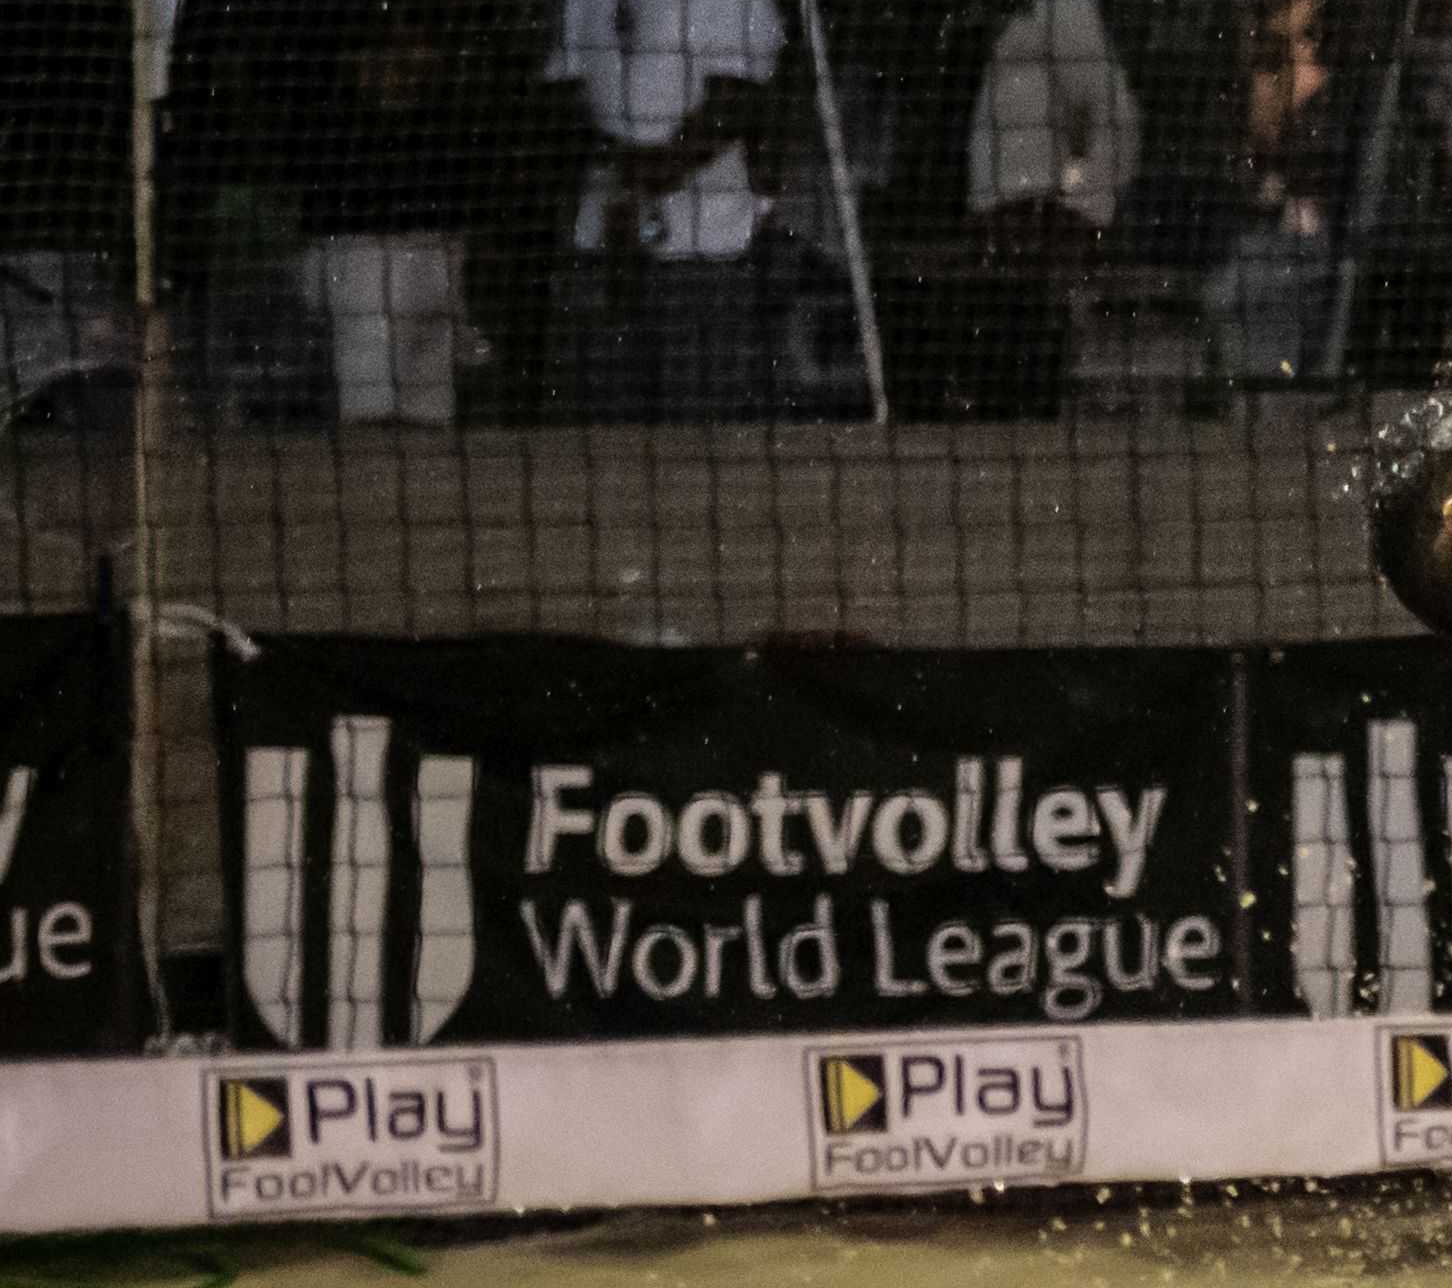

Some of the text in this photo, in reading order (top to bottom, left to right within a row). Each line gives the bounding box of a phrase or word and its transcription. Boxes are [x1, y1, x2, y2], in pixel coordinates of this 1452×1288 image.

[524, 755, 1166, 898] Footvolley
[520, 893, 1222, 1020] World League
[307, 1077, 485, 1152] Play
[900, 1053, 1075, 1128] Play
